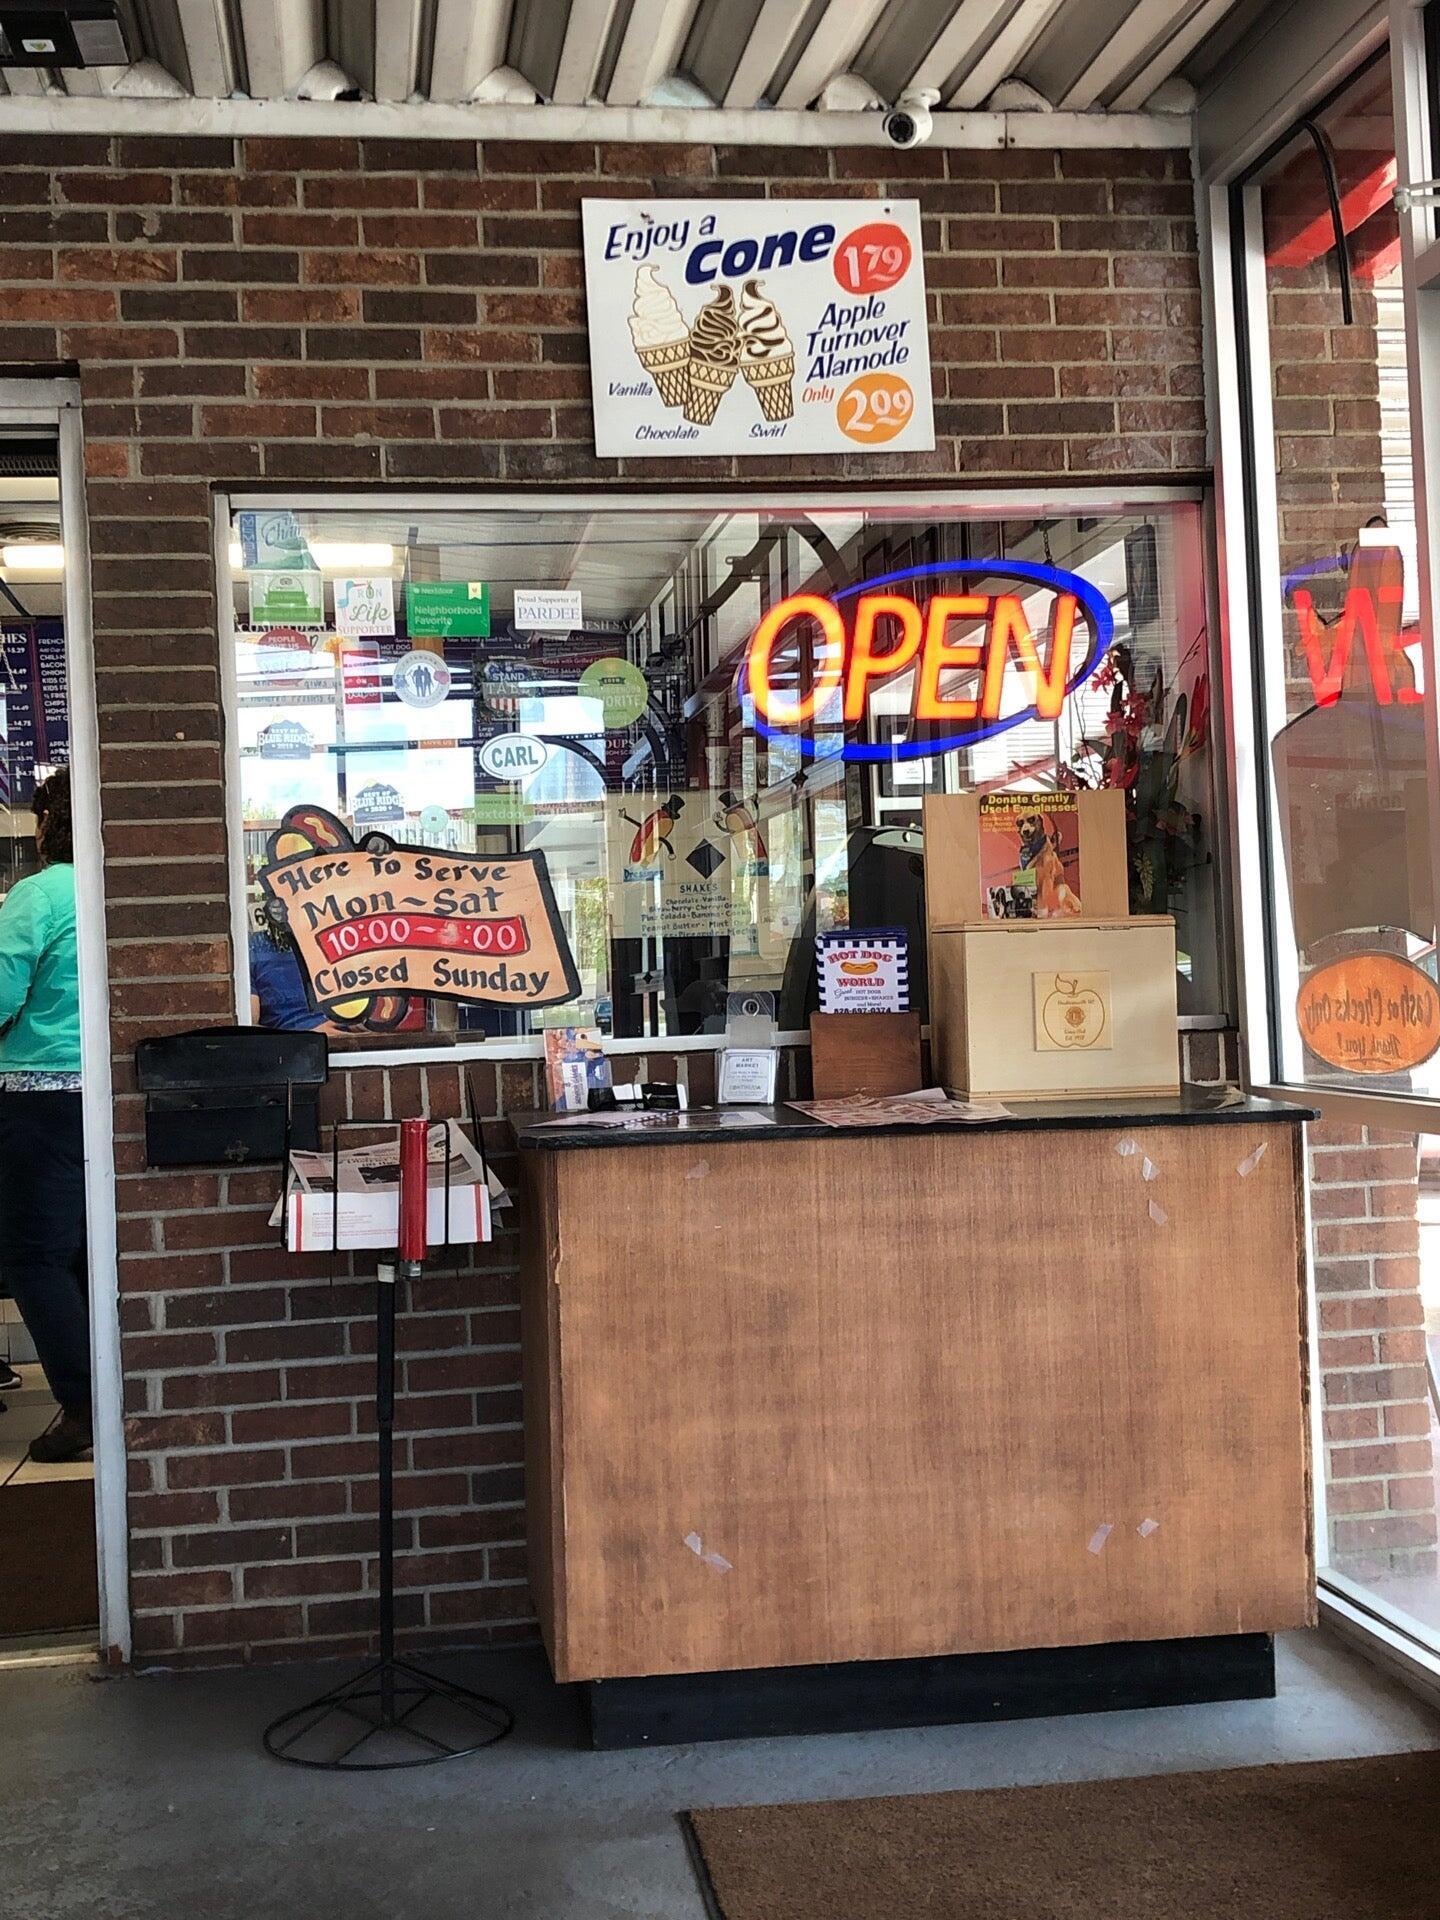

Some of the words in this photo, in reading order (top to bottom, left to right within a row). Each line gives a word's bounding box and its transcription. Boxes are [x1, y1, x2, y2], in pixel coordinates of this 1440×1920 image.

[604, 220, 689, 261] Enjoy
[699, 215, 716, 235] a
[685, 223, 835, 285] cone
[818, 296, 885, 332] Apple
[806, 319, 910, 357] Turnover
[806, 342, 909, 382] Alamode
[608, 382, 653, 397] Vanilla
[802, 385, 835, 404] Only
[635, 425, 699, 440] Chocolate
[749, 423, 788, 439] Swirl
[536, 596, 570, 605] Supporter
[349, 602, 392, 624] Life
[415, 605, 482, 616] Neighborhood
[518, 608, 581, 620] PARDEE
[414, 616, 453, 626] Favorite
[338, 625, 393, 634] SUPPORTER
[748, 592, 1078, 723] OPEN
[492, 672, 525, 681] STAND
[492, 746, 538, 768] CARL
[988, 795, 1028, 804] Donate
[1032, 794, 1069, 804] Gently
[981, 804, 1009, 814] Used
[1013, 804, 1078, 814] Eyeglasses
[278, 859, 351, 896] Here
[366, 857, 401, 877] To
[414, 857, 511, 882] Serve
[827, 950, 859, 964] HOT
[861, 950, 893, 963] DOG
[314, 957, 408, 996] Closed
[433, 957, 550, 997] Sunday
[836, 978, 885, 987] WORLD
